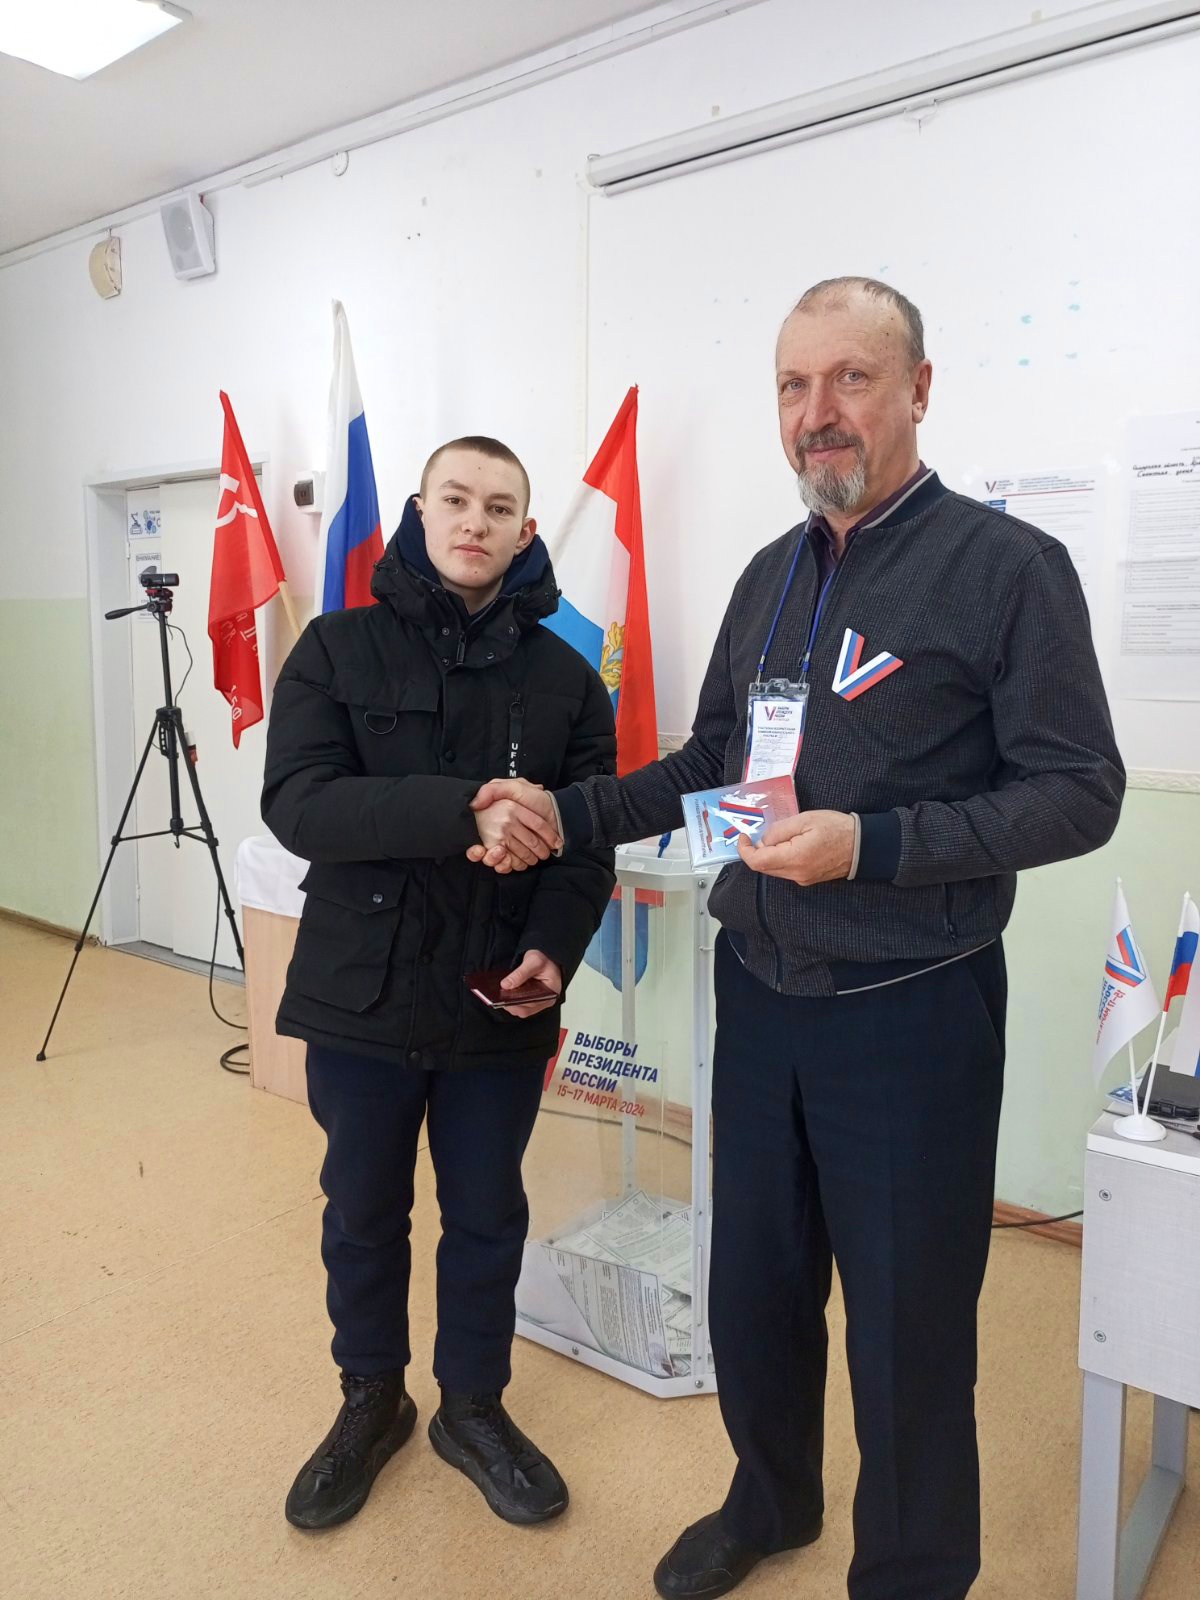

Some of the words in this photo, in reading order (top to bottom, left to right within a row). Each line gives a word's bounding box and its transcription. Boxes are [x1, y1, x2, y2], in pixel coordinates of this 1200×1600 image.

[574, 1031, 638, 1058] ВЫБОРЫ
[567, 1049, 659, 1083] ПРЕЗИДЕНТА
[561, 1067, 618, 1093] РОССИИ
[584, 1091, 617, 1111] МАРТА
[619, 1100, 646, 1117] 2024
